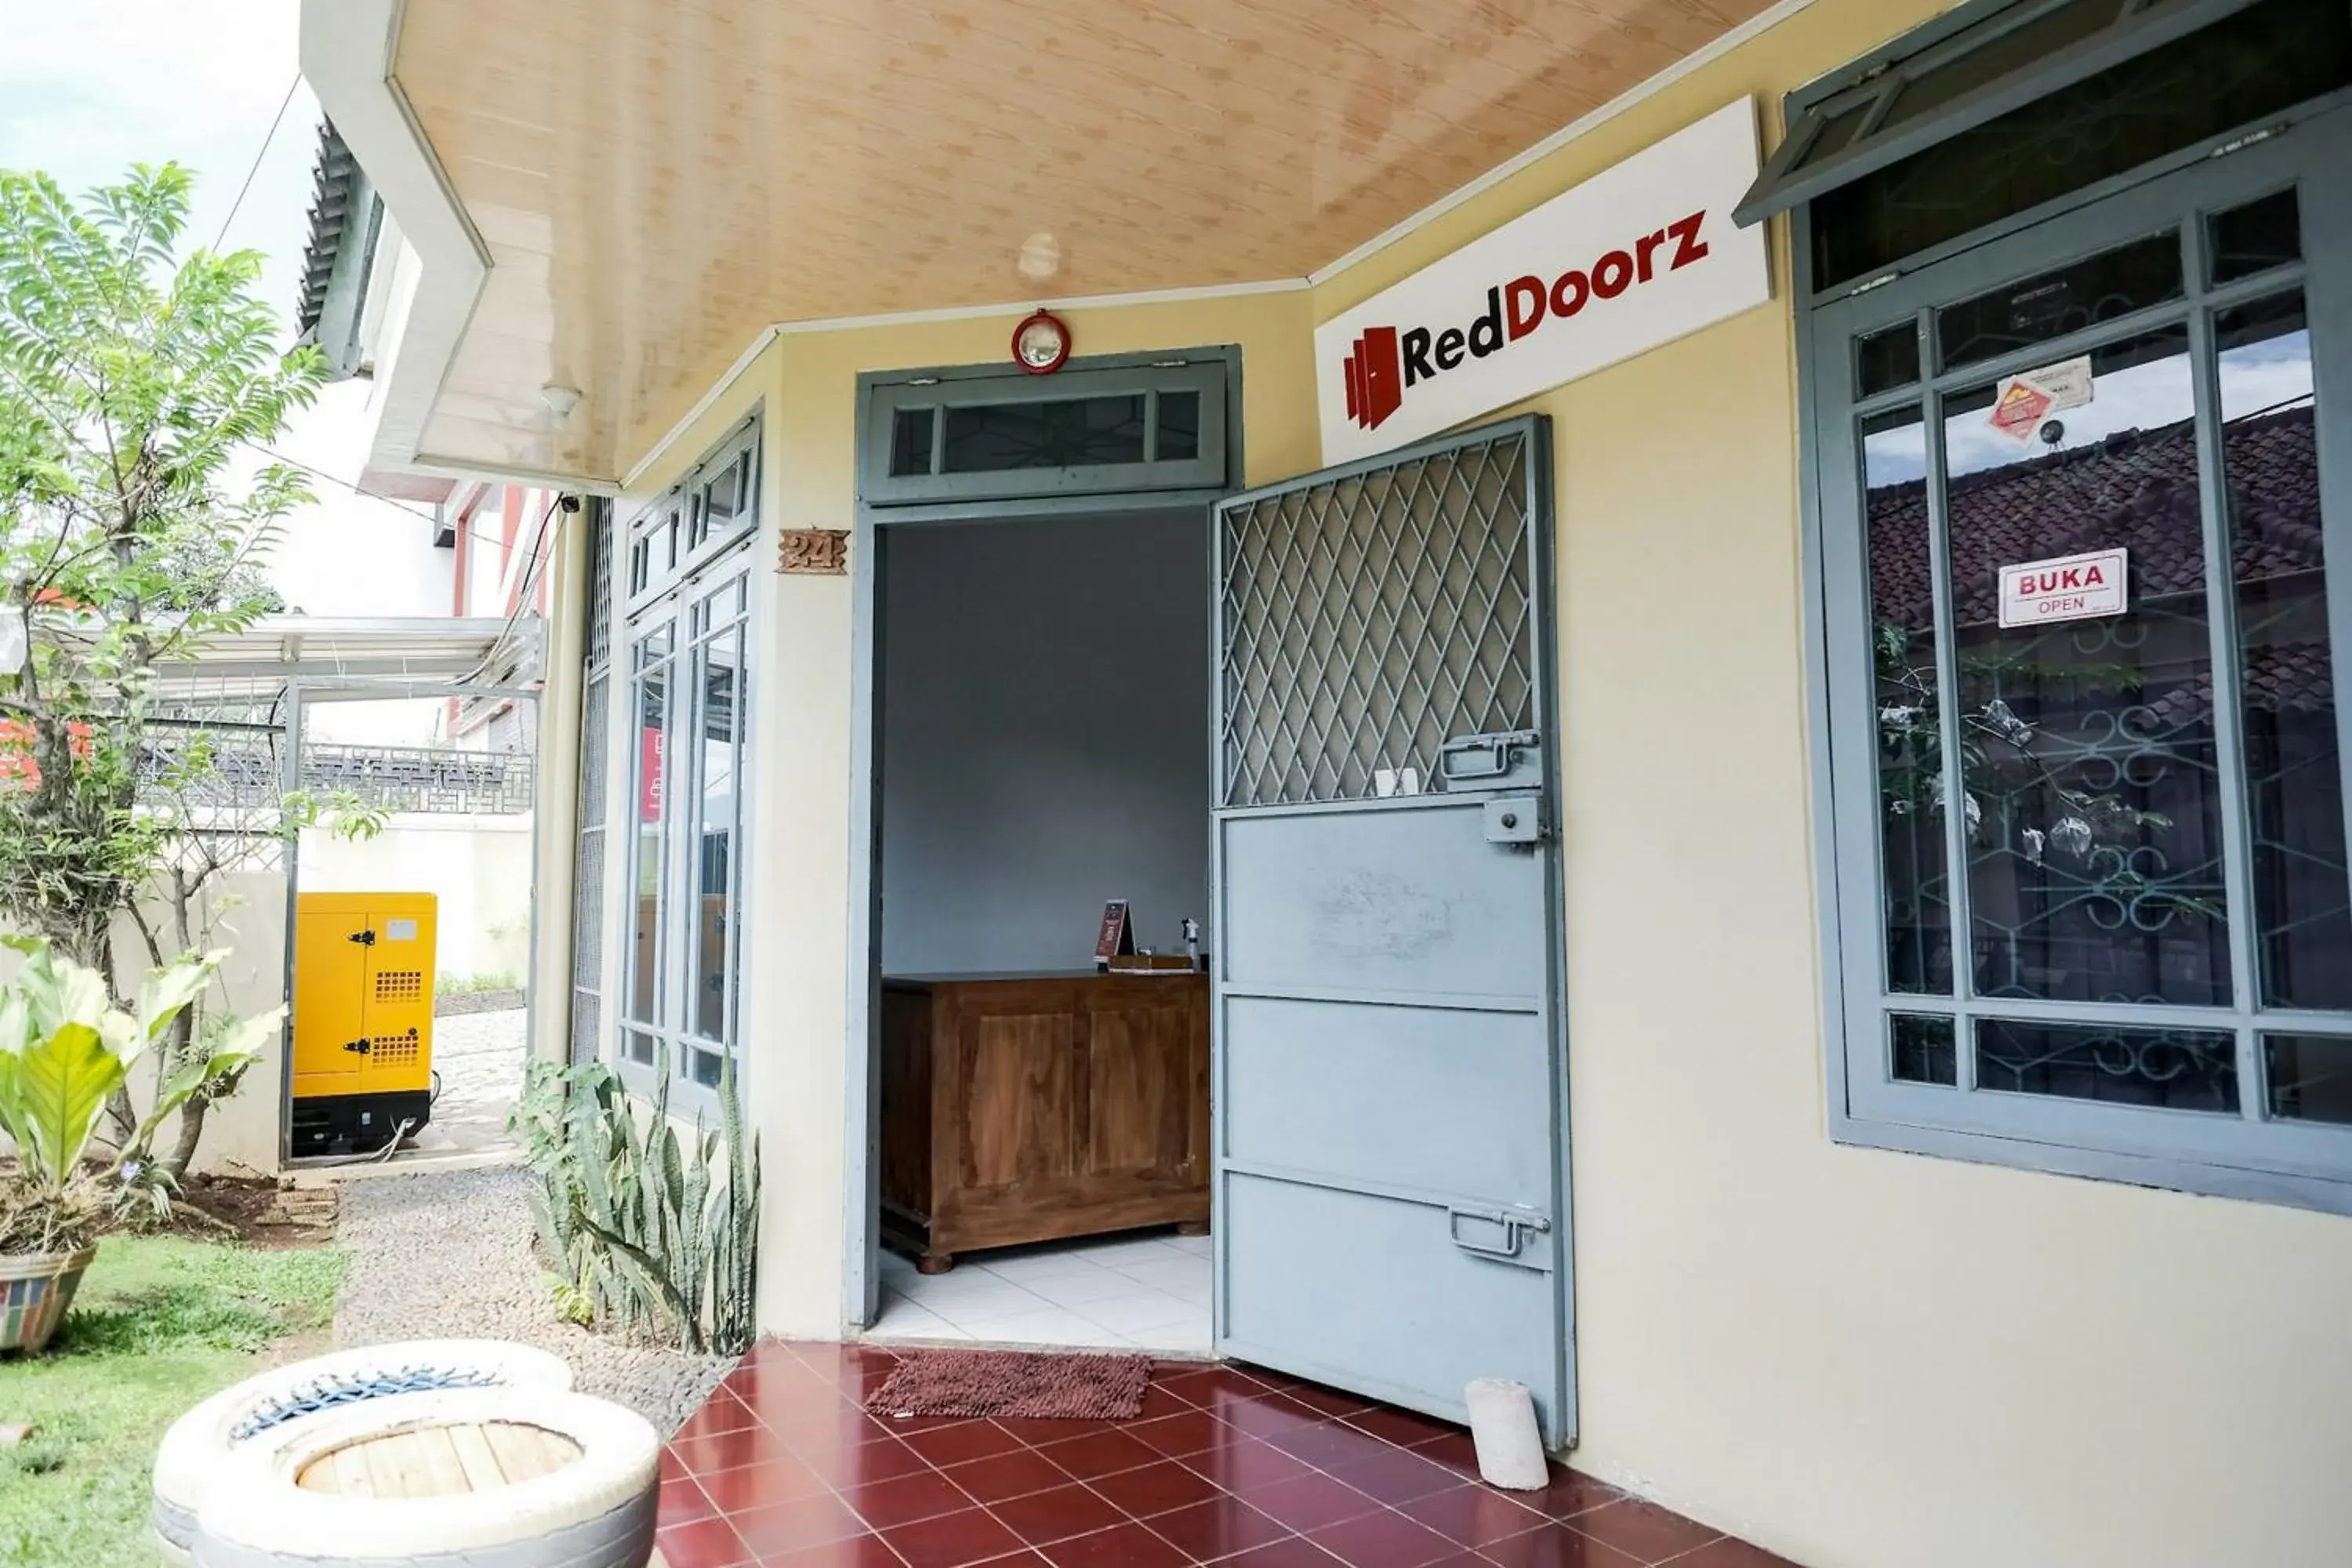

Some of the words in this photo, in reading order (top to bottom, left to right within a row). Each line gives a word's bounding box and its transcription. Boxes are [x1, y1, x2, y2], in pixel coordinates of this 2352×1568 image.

[1402, 209, 1709, 387] RedDoorz
[787, 535, 835, 568] 24
[2020, 565, 2104, 595] BUKA
[2039, 597, 2085, 614] OPEN
